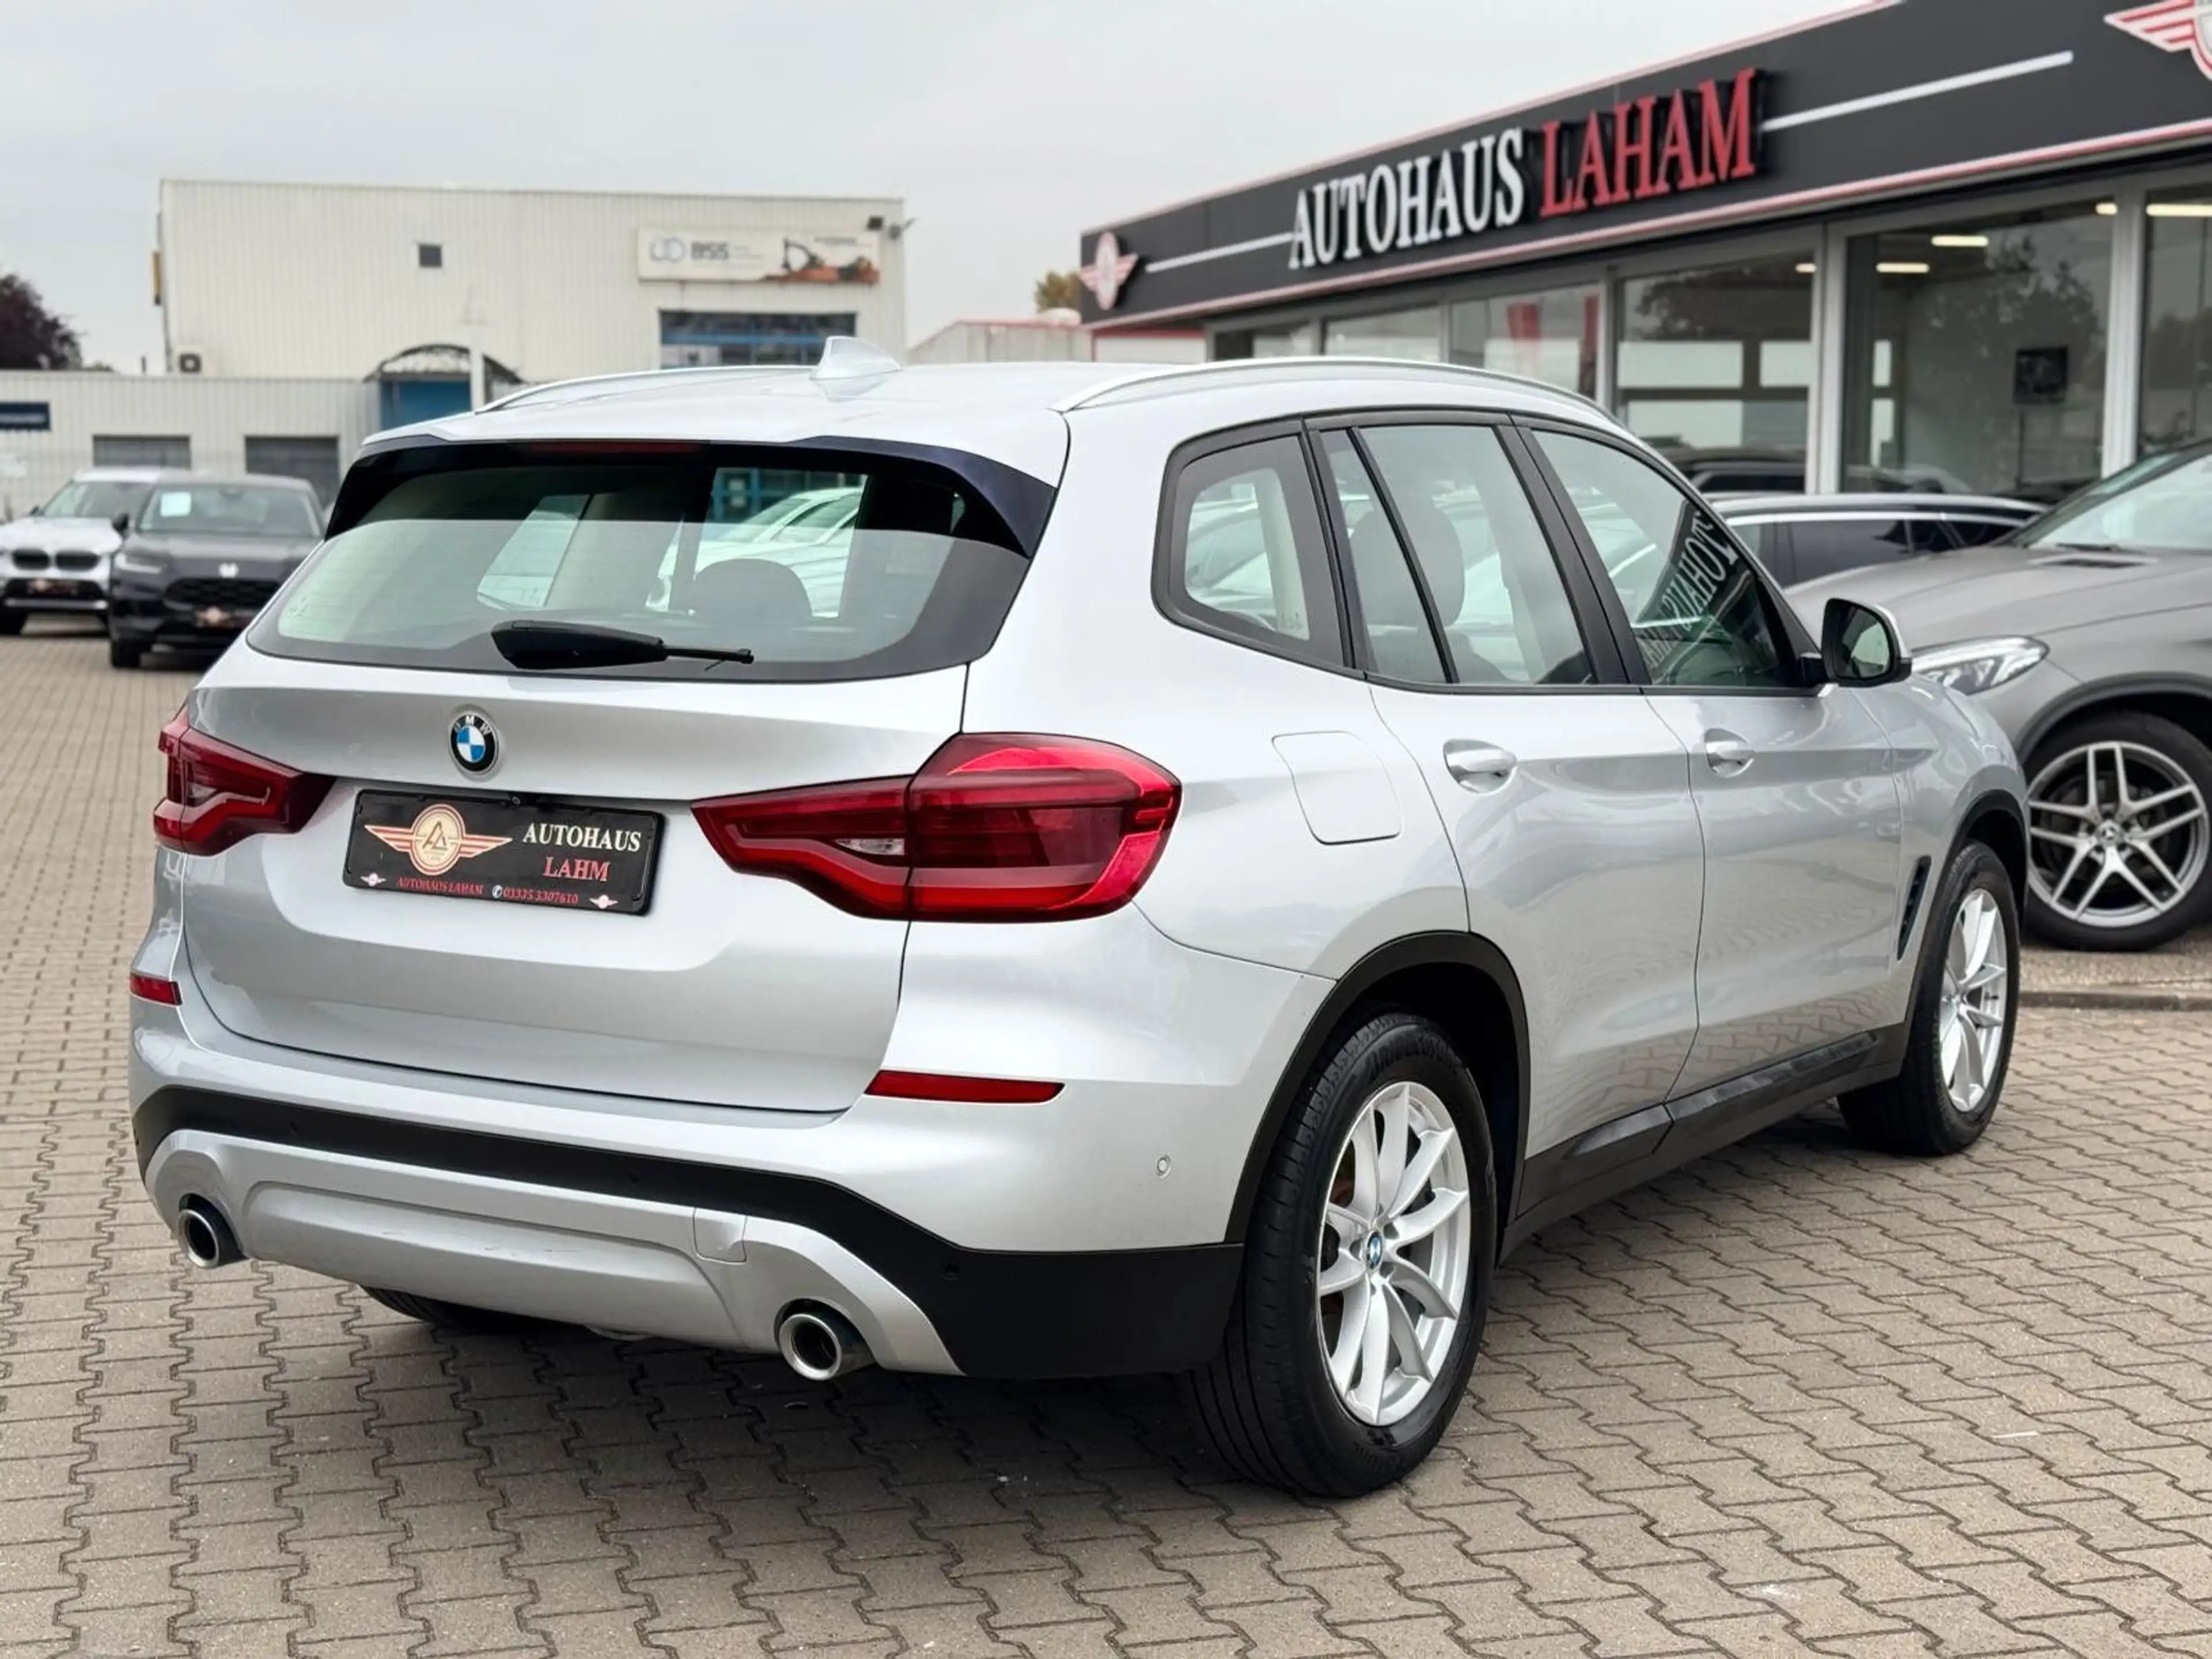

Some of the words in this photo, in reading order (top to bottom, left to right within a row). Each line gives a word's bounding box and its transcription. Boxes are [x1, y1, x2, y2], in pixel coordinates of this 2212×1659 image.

[1288, 128, 1525, 270] AUTOHAUS
[1540, 67, 1758, 218] LAHAM
[522, 823, 641, 851] AUTOHAUS
[543, 857, 611, 881] LAHM
[397, 877, 448, 892] AUTOHAUS
